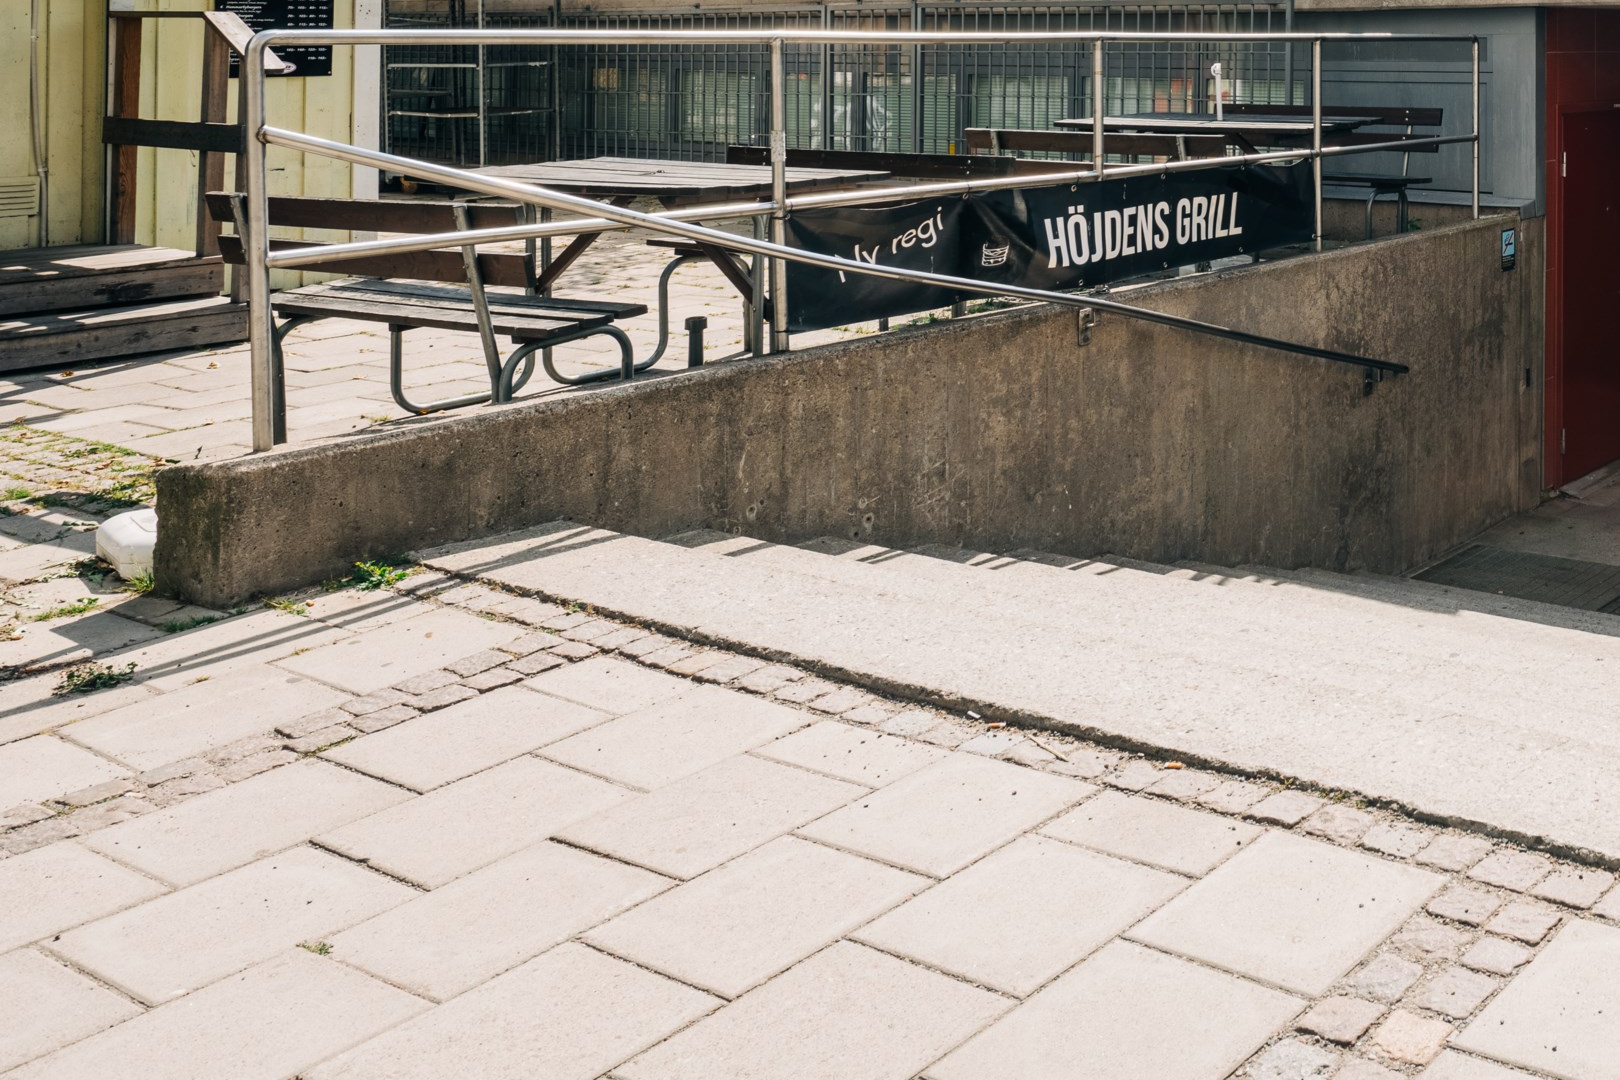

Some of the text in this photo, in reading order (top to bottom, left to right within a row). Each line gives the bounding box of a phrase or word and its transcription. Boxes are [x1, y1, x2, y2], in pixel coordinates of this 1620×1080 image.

[891, 206, 944, 254] regi
[1044, 190, 1244, 270] HÖJDENS GRILL
